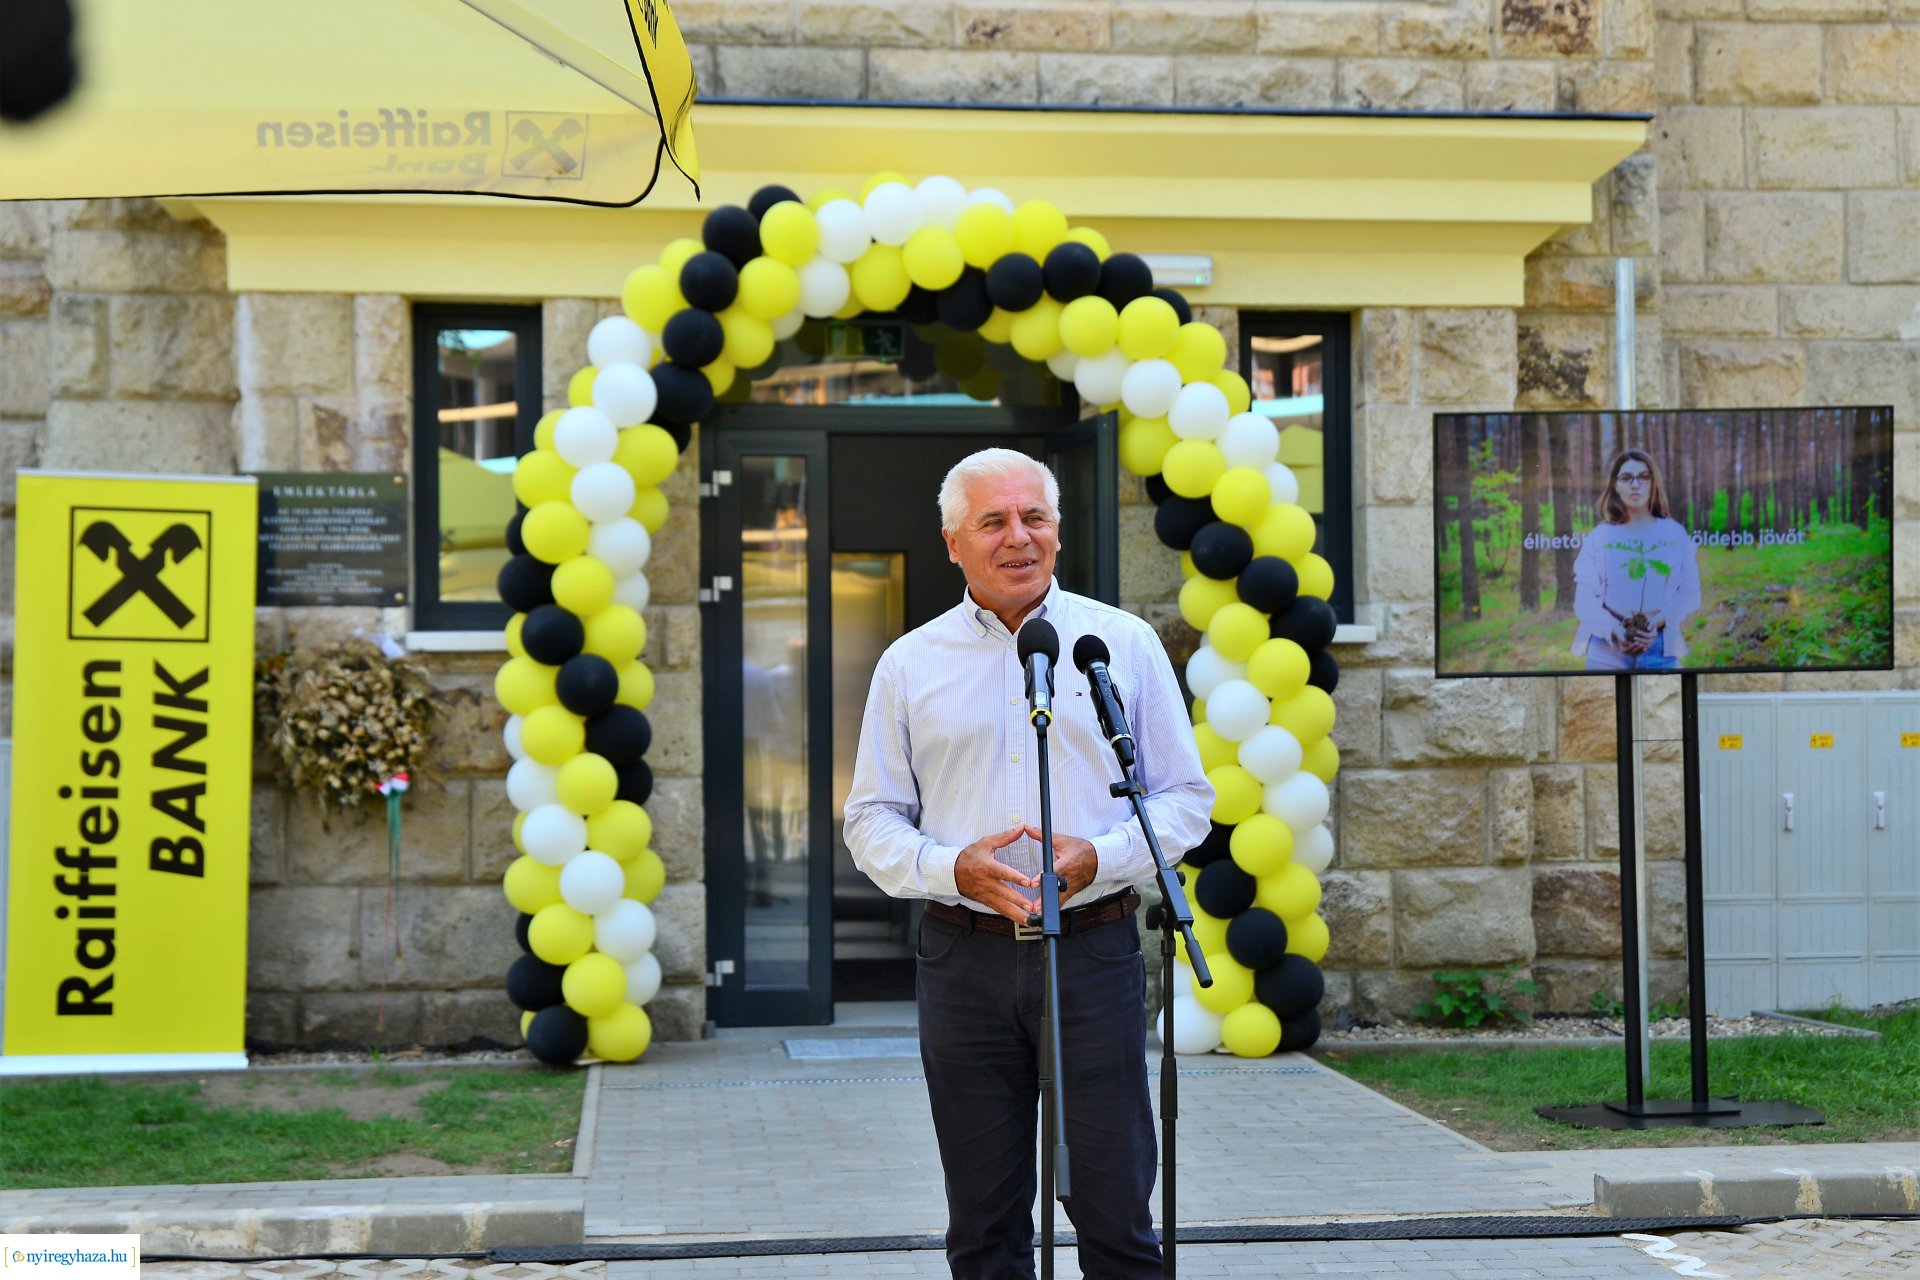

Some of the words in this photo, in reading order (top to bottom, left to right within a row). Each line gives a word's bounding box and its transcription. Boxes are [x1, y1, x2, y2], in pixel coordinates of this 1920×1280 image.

[1523, 531, 1585, 550] élhető
[1687, 529, 1755, 547] öldebb
[1757, 528, 1805, 549] jövőt
[54, 659, 123, 1016] Raiffeisen
[149, 658, 210, 878] BANK
